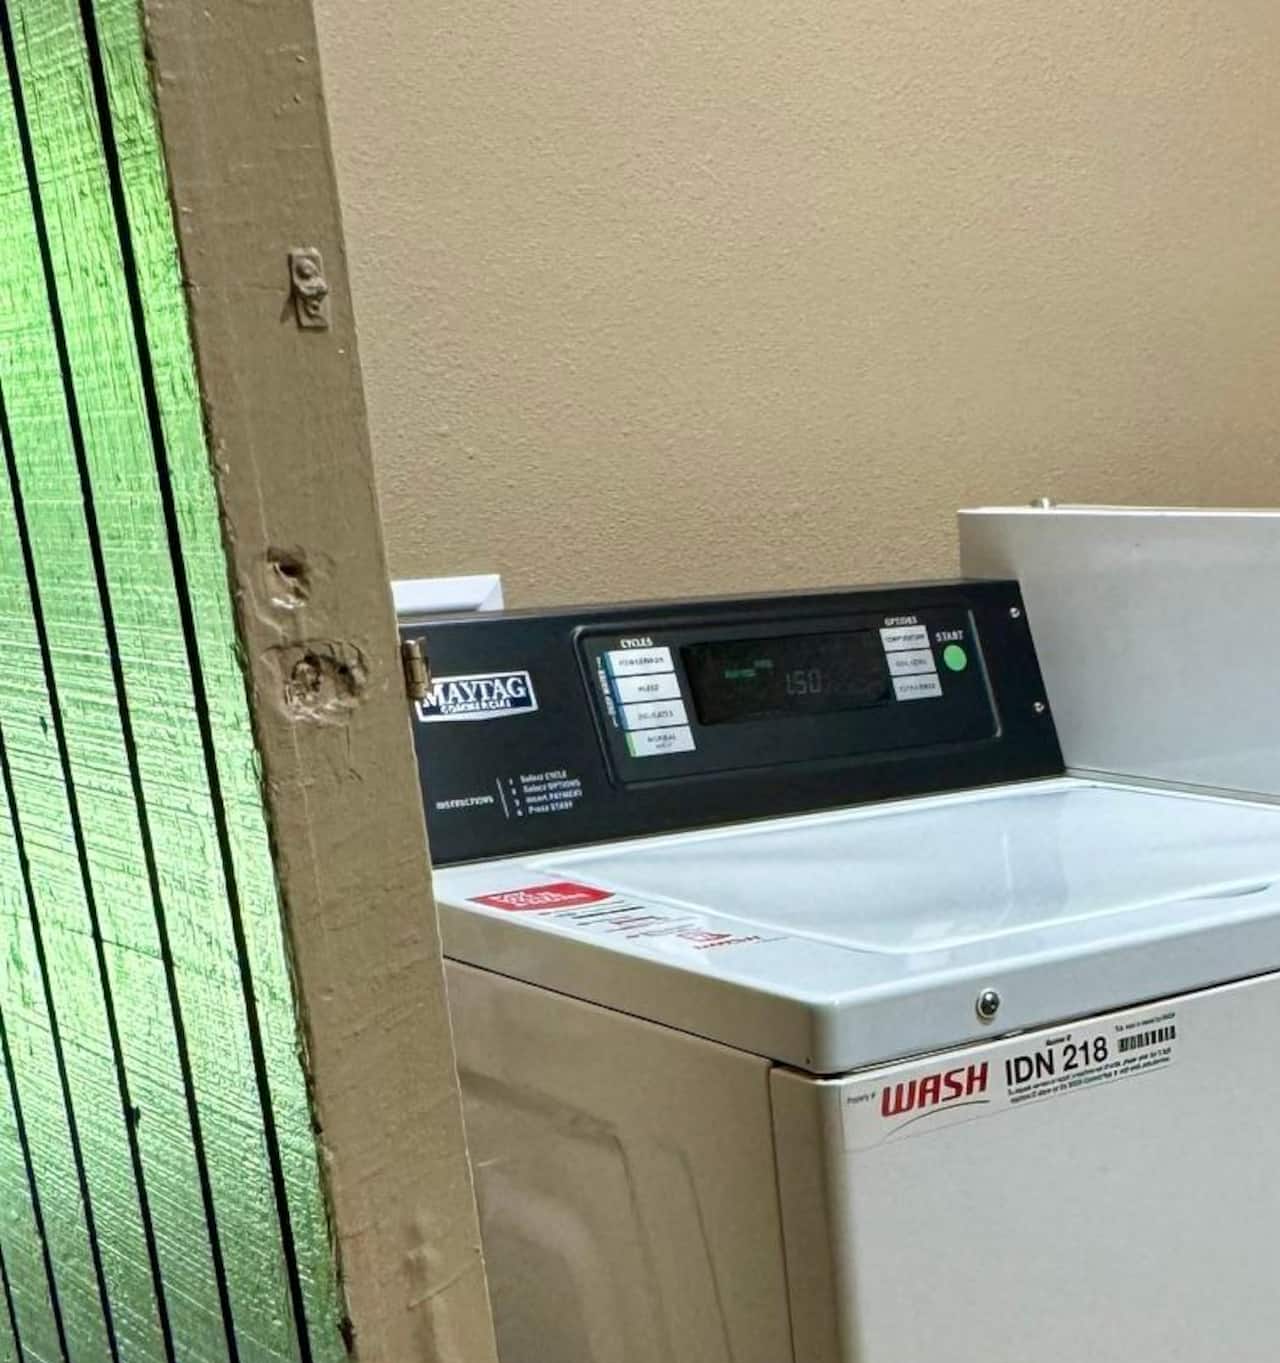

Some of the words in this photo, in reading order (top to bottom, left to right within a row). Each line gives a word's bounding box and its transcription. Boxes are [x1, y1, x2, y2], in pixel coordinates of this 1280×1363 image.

[620, 637, 653, 648] CYCLES
[936, 630, 964, 641] START
[422, 677, 527, 708] MAYTAG
[1005, 1048, 1055, 1086] IDN
[1063, 1036, 1108, 1072] 218
[882, 1061, 989, 1117] WASH
